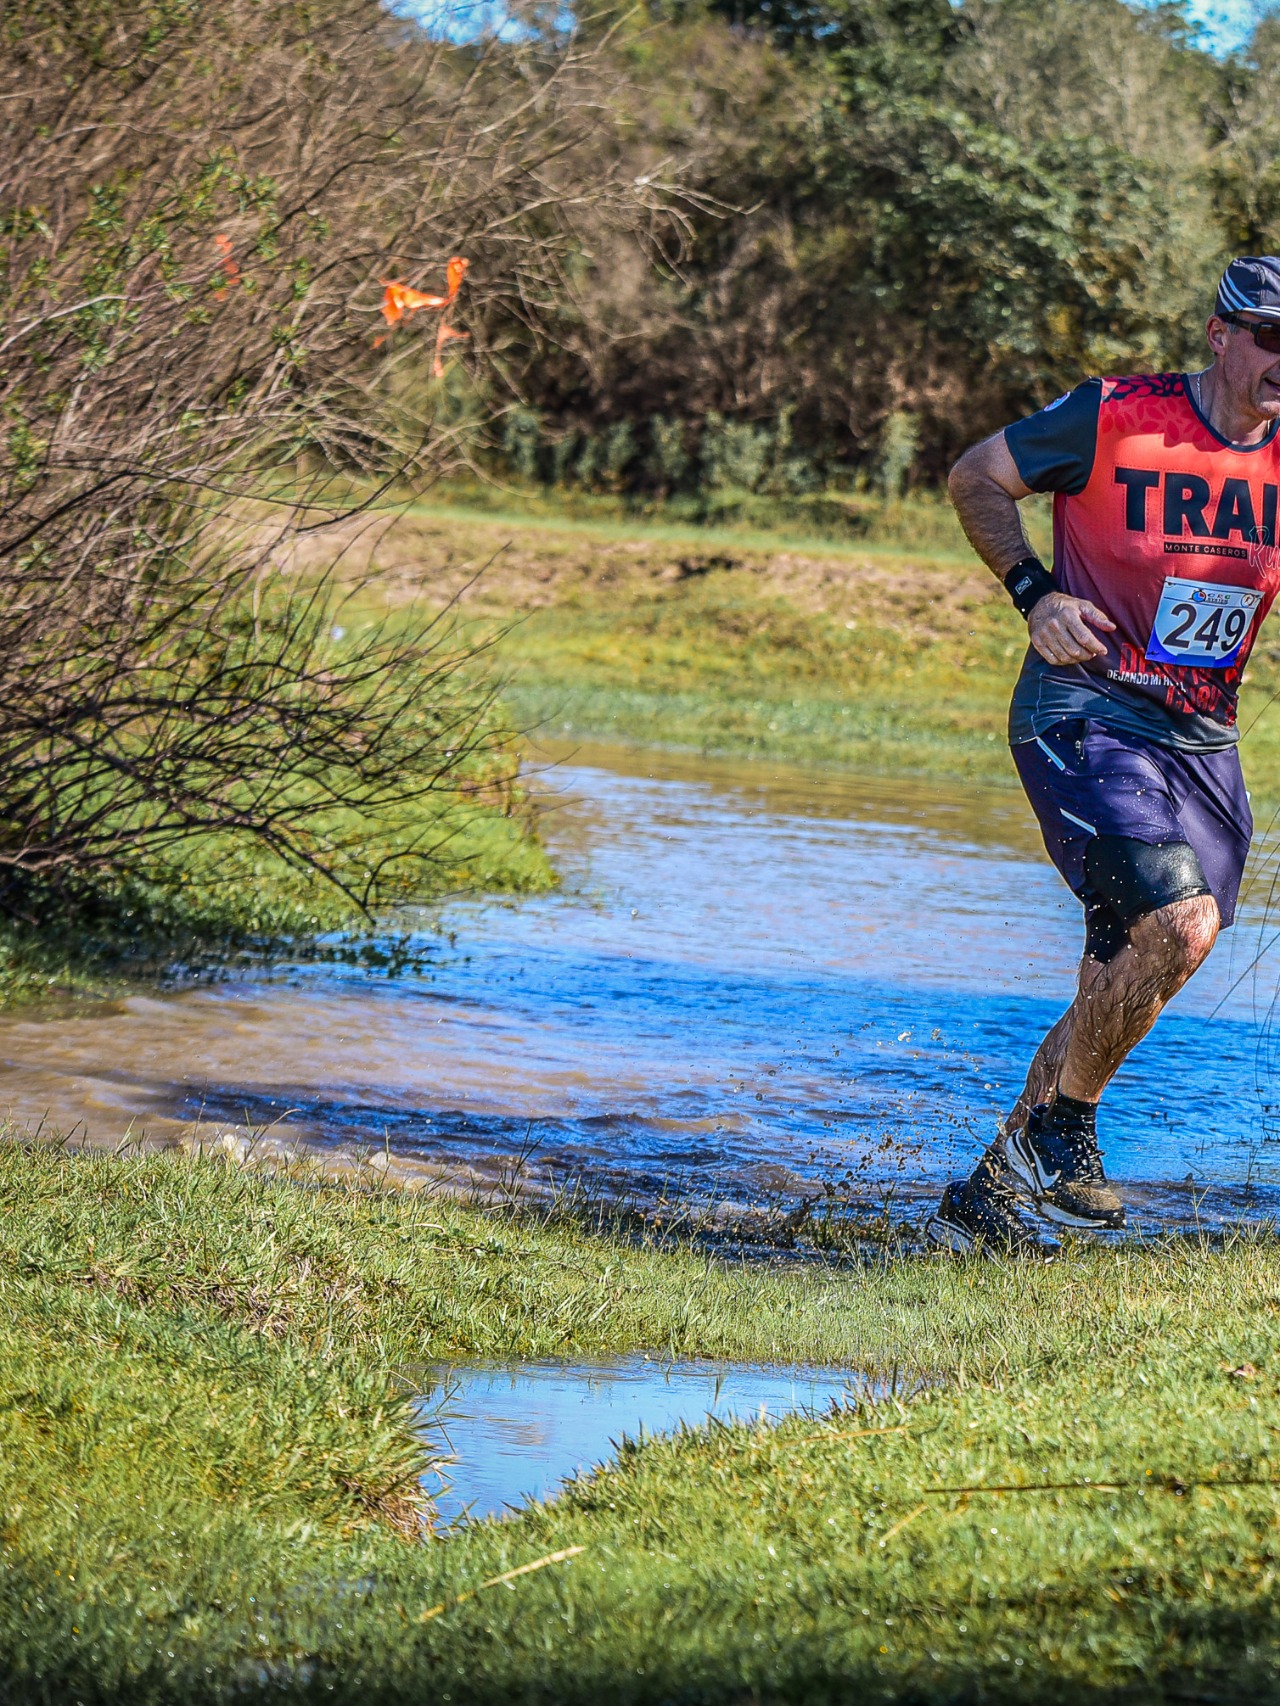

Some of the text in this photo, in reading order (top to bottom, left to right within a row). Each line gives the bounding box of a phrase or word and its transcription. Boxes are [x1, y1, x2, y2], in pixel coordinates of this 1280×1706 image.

[1165, 543, 1247, 559] MONTE CASEROS
[1162, 603, 1246, 651] 249
[1107, 669, 1149, 685] DEJANDO
[1150, 674, 1162, 686] MI
